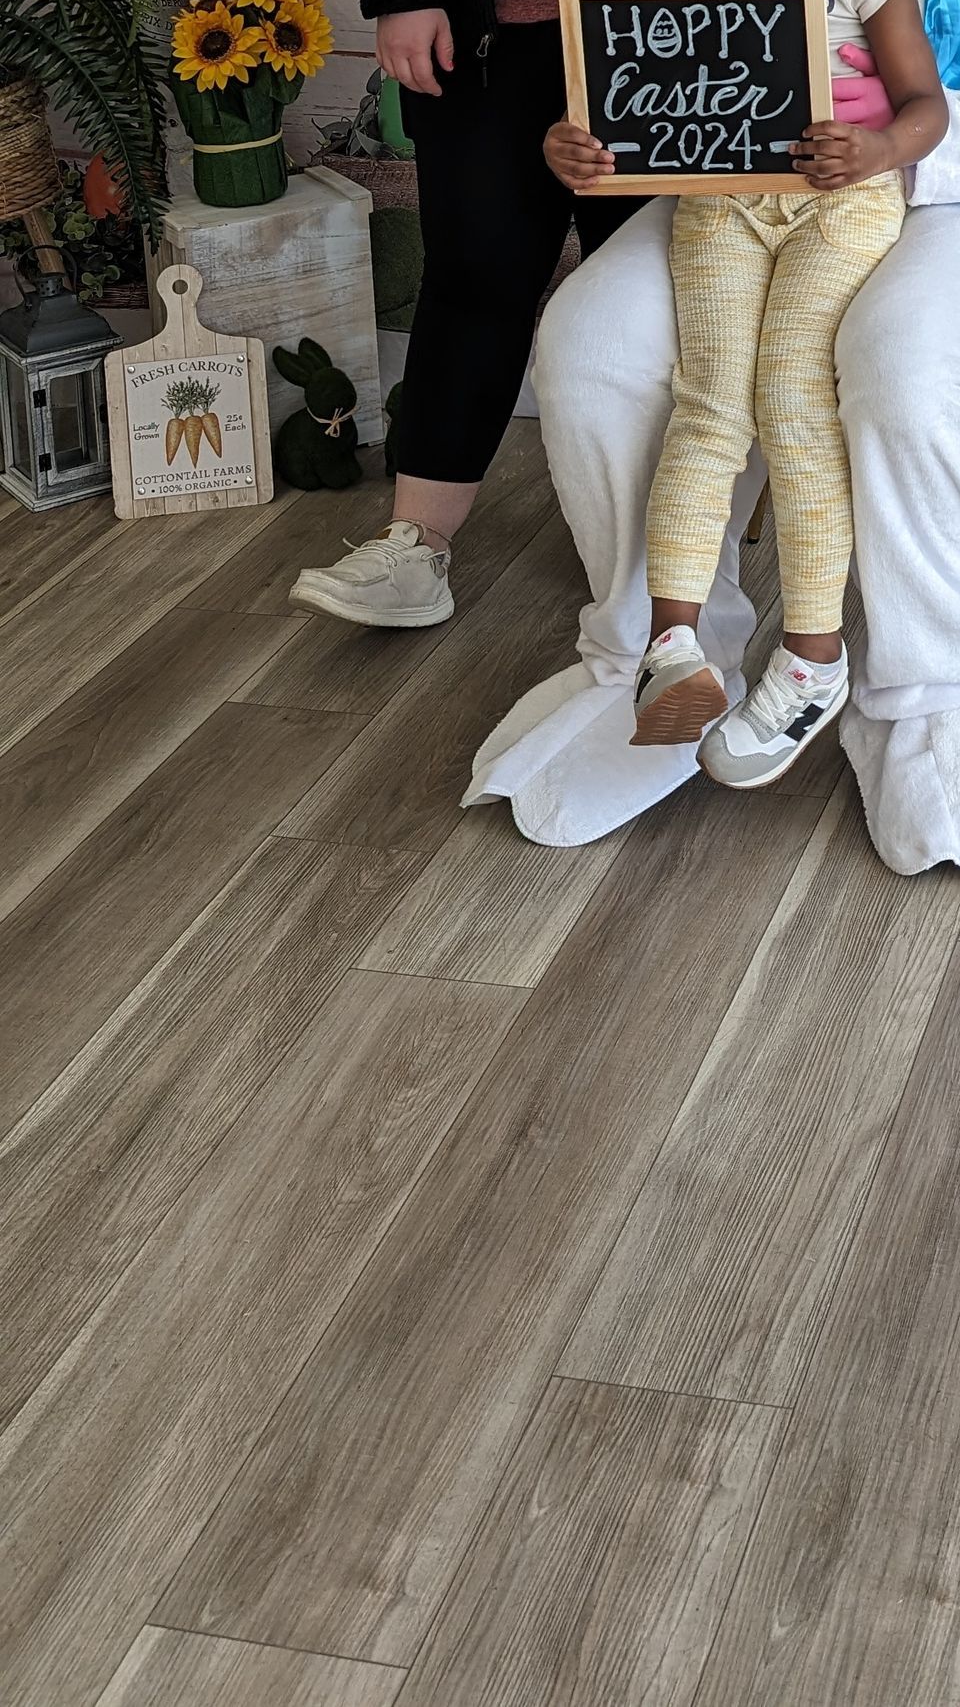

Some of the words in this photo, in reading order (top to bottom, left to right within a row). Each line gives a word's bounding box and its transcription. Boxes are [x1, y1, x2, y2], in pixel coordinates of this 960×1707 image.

[604, 61, 794, 122] Easter
[649, 119, 762, 170] 2024
[131, 364, 175, 388] FRESH
[178, 361, 244, 377] CARROTS
[133, 422, 160, 432] Locally
[224, 423, 247, 432] Each
[134, 432, 160, 441] Grown
[135, 470, 211, 486] COTTONTAIL
[213, 465, 252, 478] FARMS
[159, 485, 182, 494] 100%
[185, 479, 232, 491] ORGANIC
